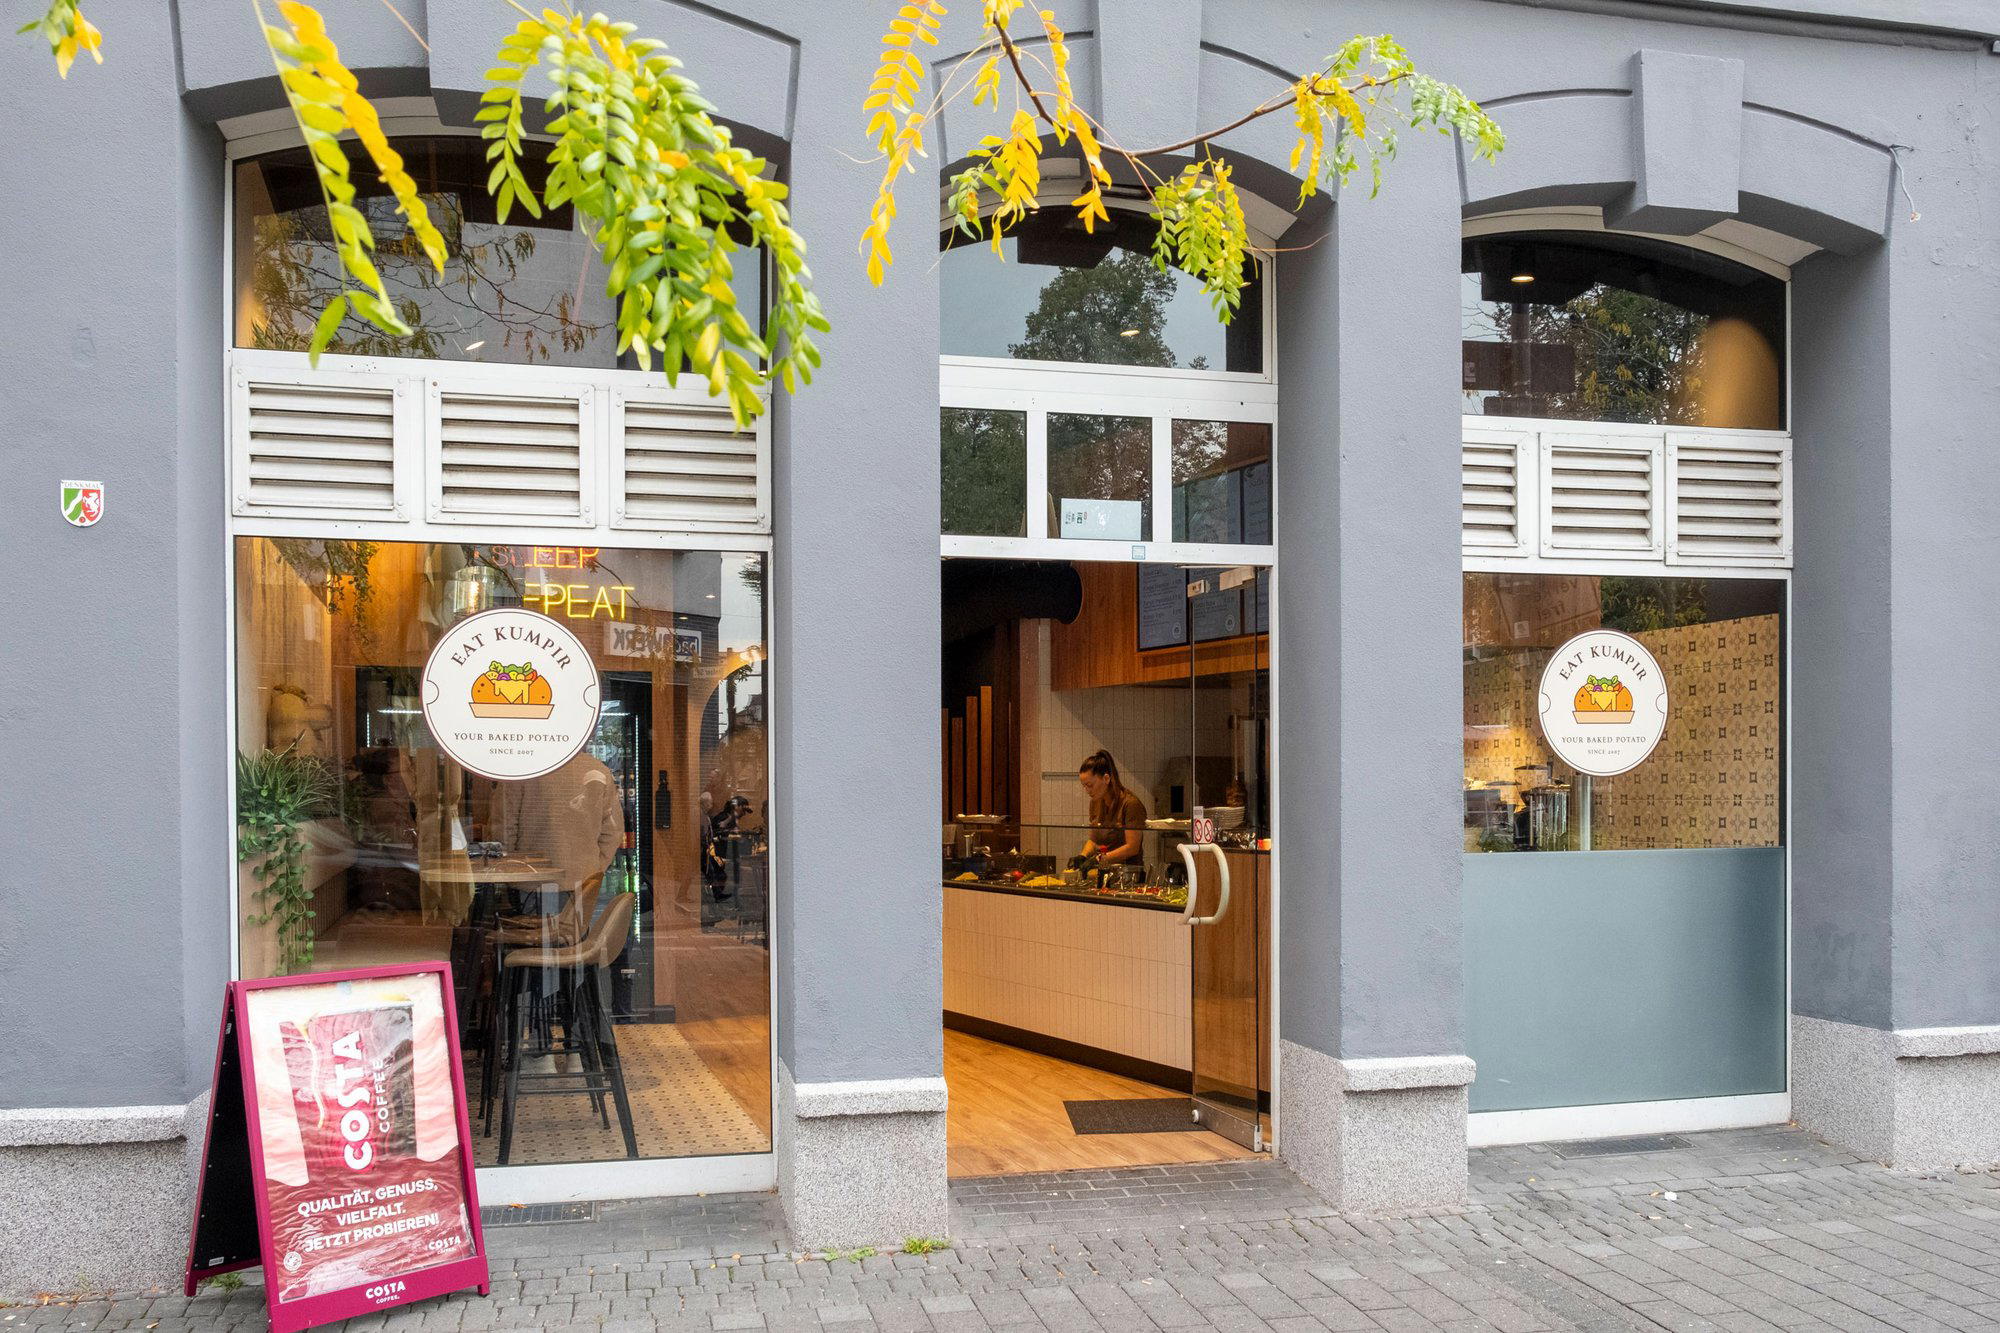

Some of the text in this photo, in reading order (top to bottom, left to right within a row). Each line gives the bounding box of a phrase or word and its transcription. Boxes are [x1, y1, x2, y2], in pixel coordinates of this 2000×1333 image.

[451, 626, 572, 670] EAT KUMPIR
[1559, 645, 1647, 681] EAT KUMPIR
[454, 732, 570, 743] YOUR BAKED POTATO
[1562, 736, 1583, 744] YOUR
[1615, 736, 1647, 744] POTATO
[1587, 748, 1606, 756] SINCE
[331, 1030, 374, 1171] COSTA
[372, 1059, 391, 1134] COFFEE
[297, 1177, 438, 1217] QUALITÄT, GENUSS,
[336, 1202, 407, 1227] VIELFALT.
[303, 1213, 440, 1253] JETZT PROBIEREN!
[428, 1235, 462, 1251] COSTA
[365, 1280, 406, 1299] COSTA
